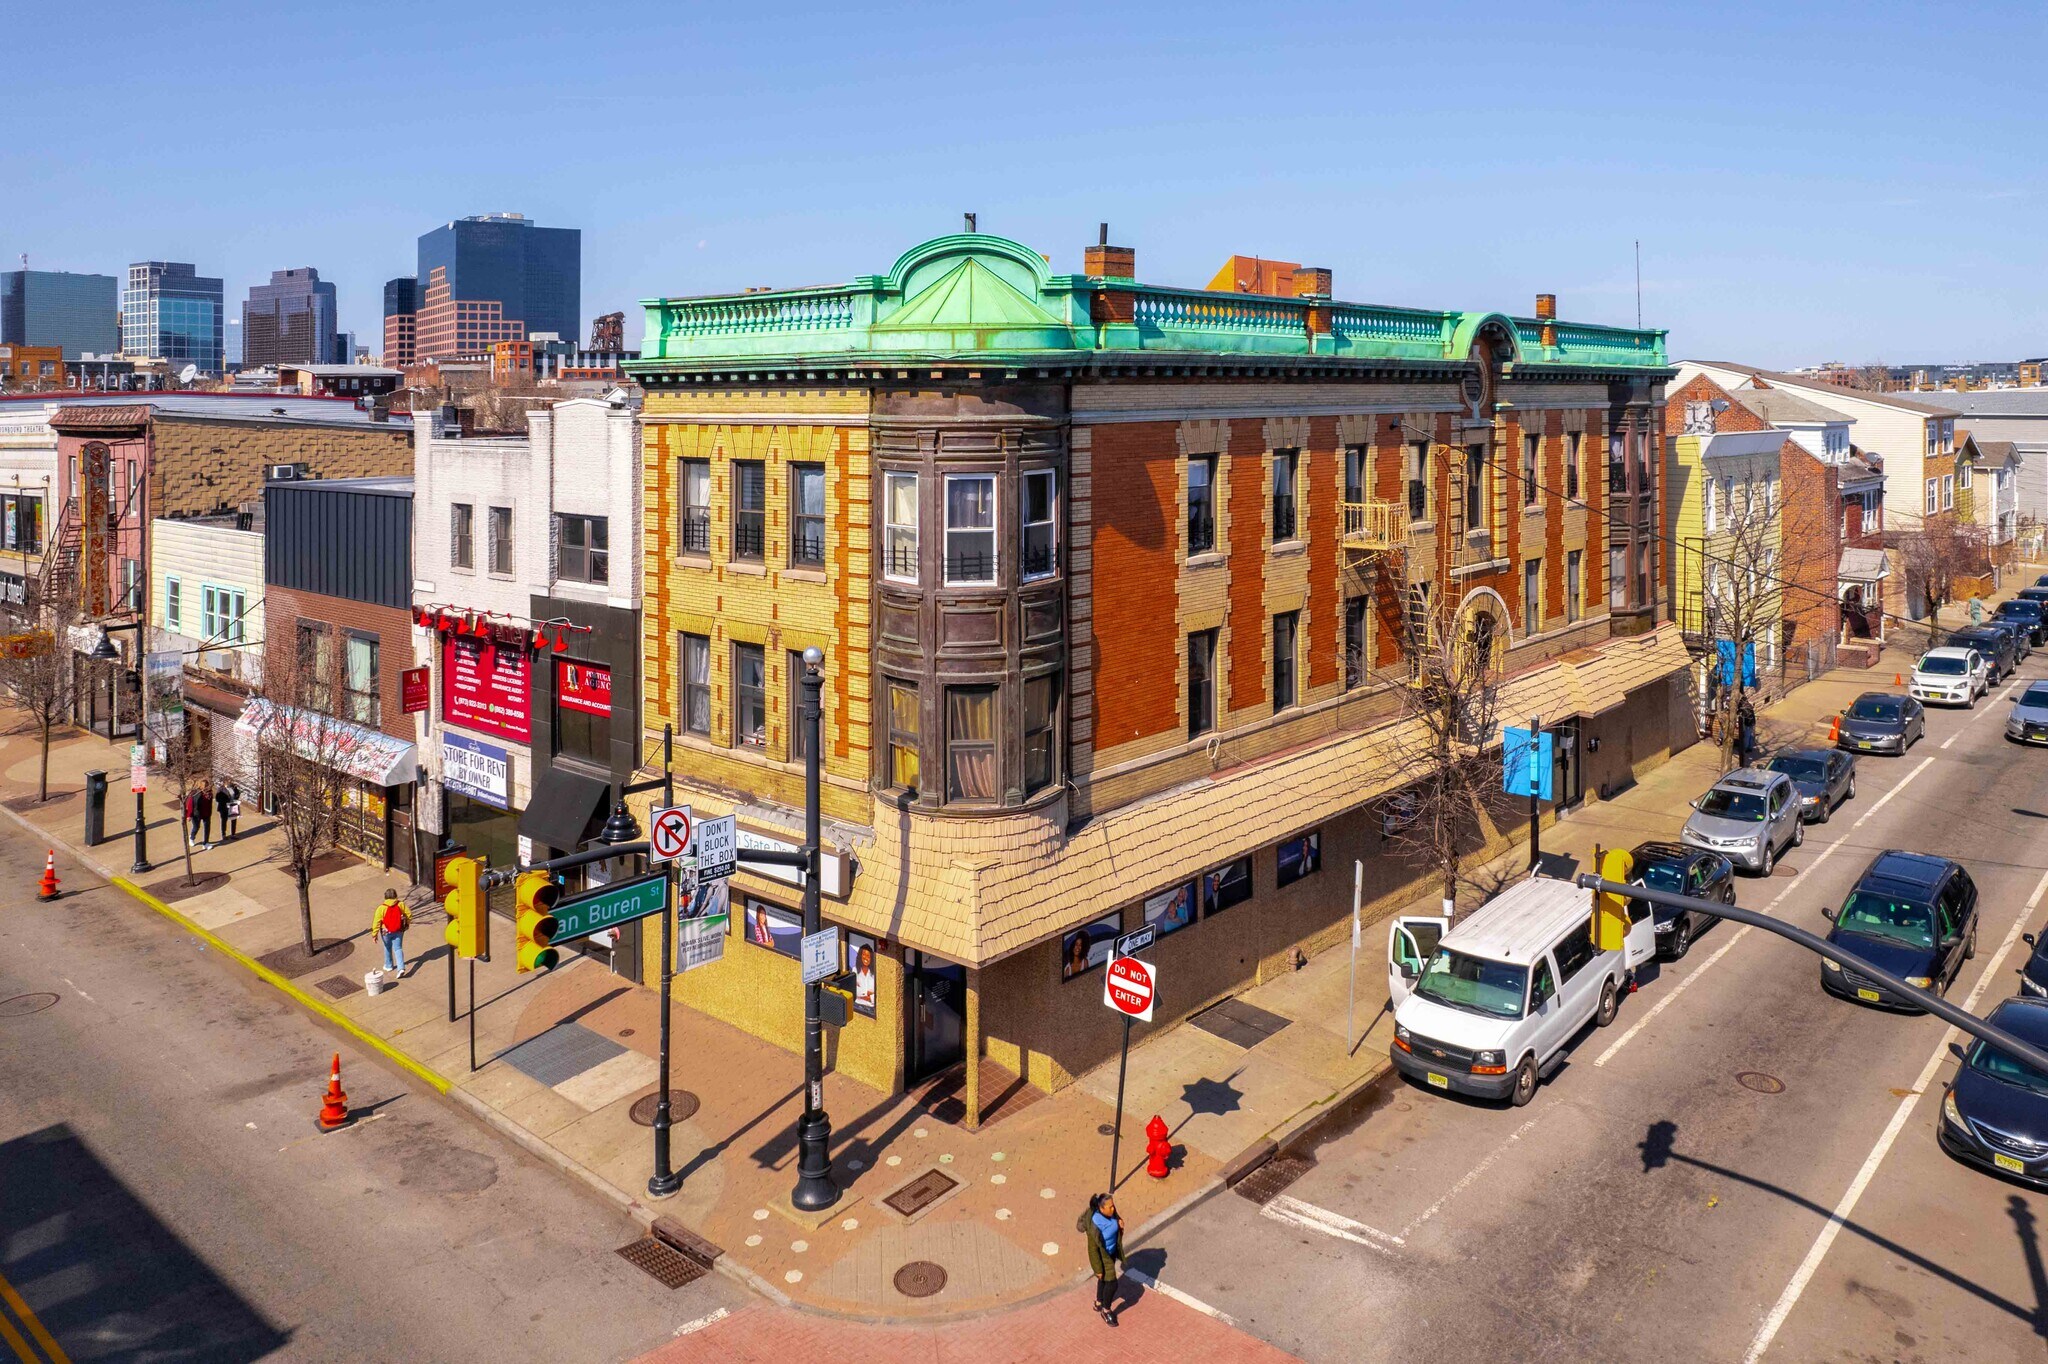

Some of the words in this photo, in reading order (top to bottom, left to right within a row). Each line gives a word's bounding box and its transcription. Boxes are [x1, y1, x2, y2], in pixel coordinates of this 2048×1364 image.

[482, 621, 529, 652] gency
[585, 678, 611, 691] AGENC
[562, 695, 583, 704] INSURANCE
[444, 746, 468, 766] STORE
[470, 754, 485, 771] FOR
[487, 759, 505, 778] RENT
[459, 767, 468, 781] BY
[469, 771, 490, 789] OWNER
[706, 821, 728, 836] DON'T
[704, 835, 729, 852] BLOCK
[744, 834, 770, 850] State
[700, 853, 714, 868] THE
[720, 848, 734, 861] BOX
[557, 914, 578, 933] an
[589, 896, 640, 924] Buren
[650, 886, 659, 896] St
[1128, 938, 1139, 949] ONE
[1140, 933, 1152, 944] WAY
[1114, 964, 1126, 975] DO
[1130, 970, 1148, 983] NOT
[1115, 989, 1142, 1007] ENTER
